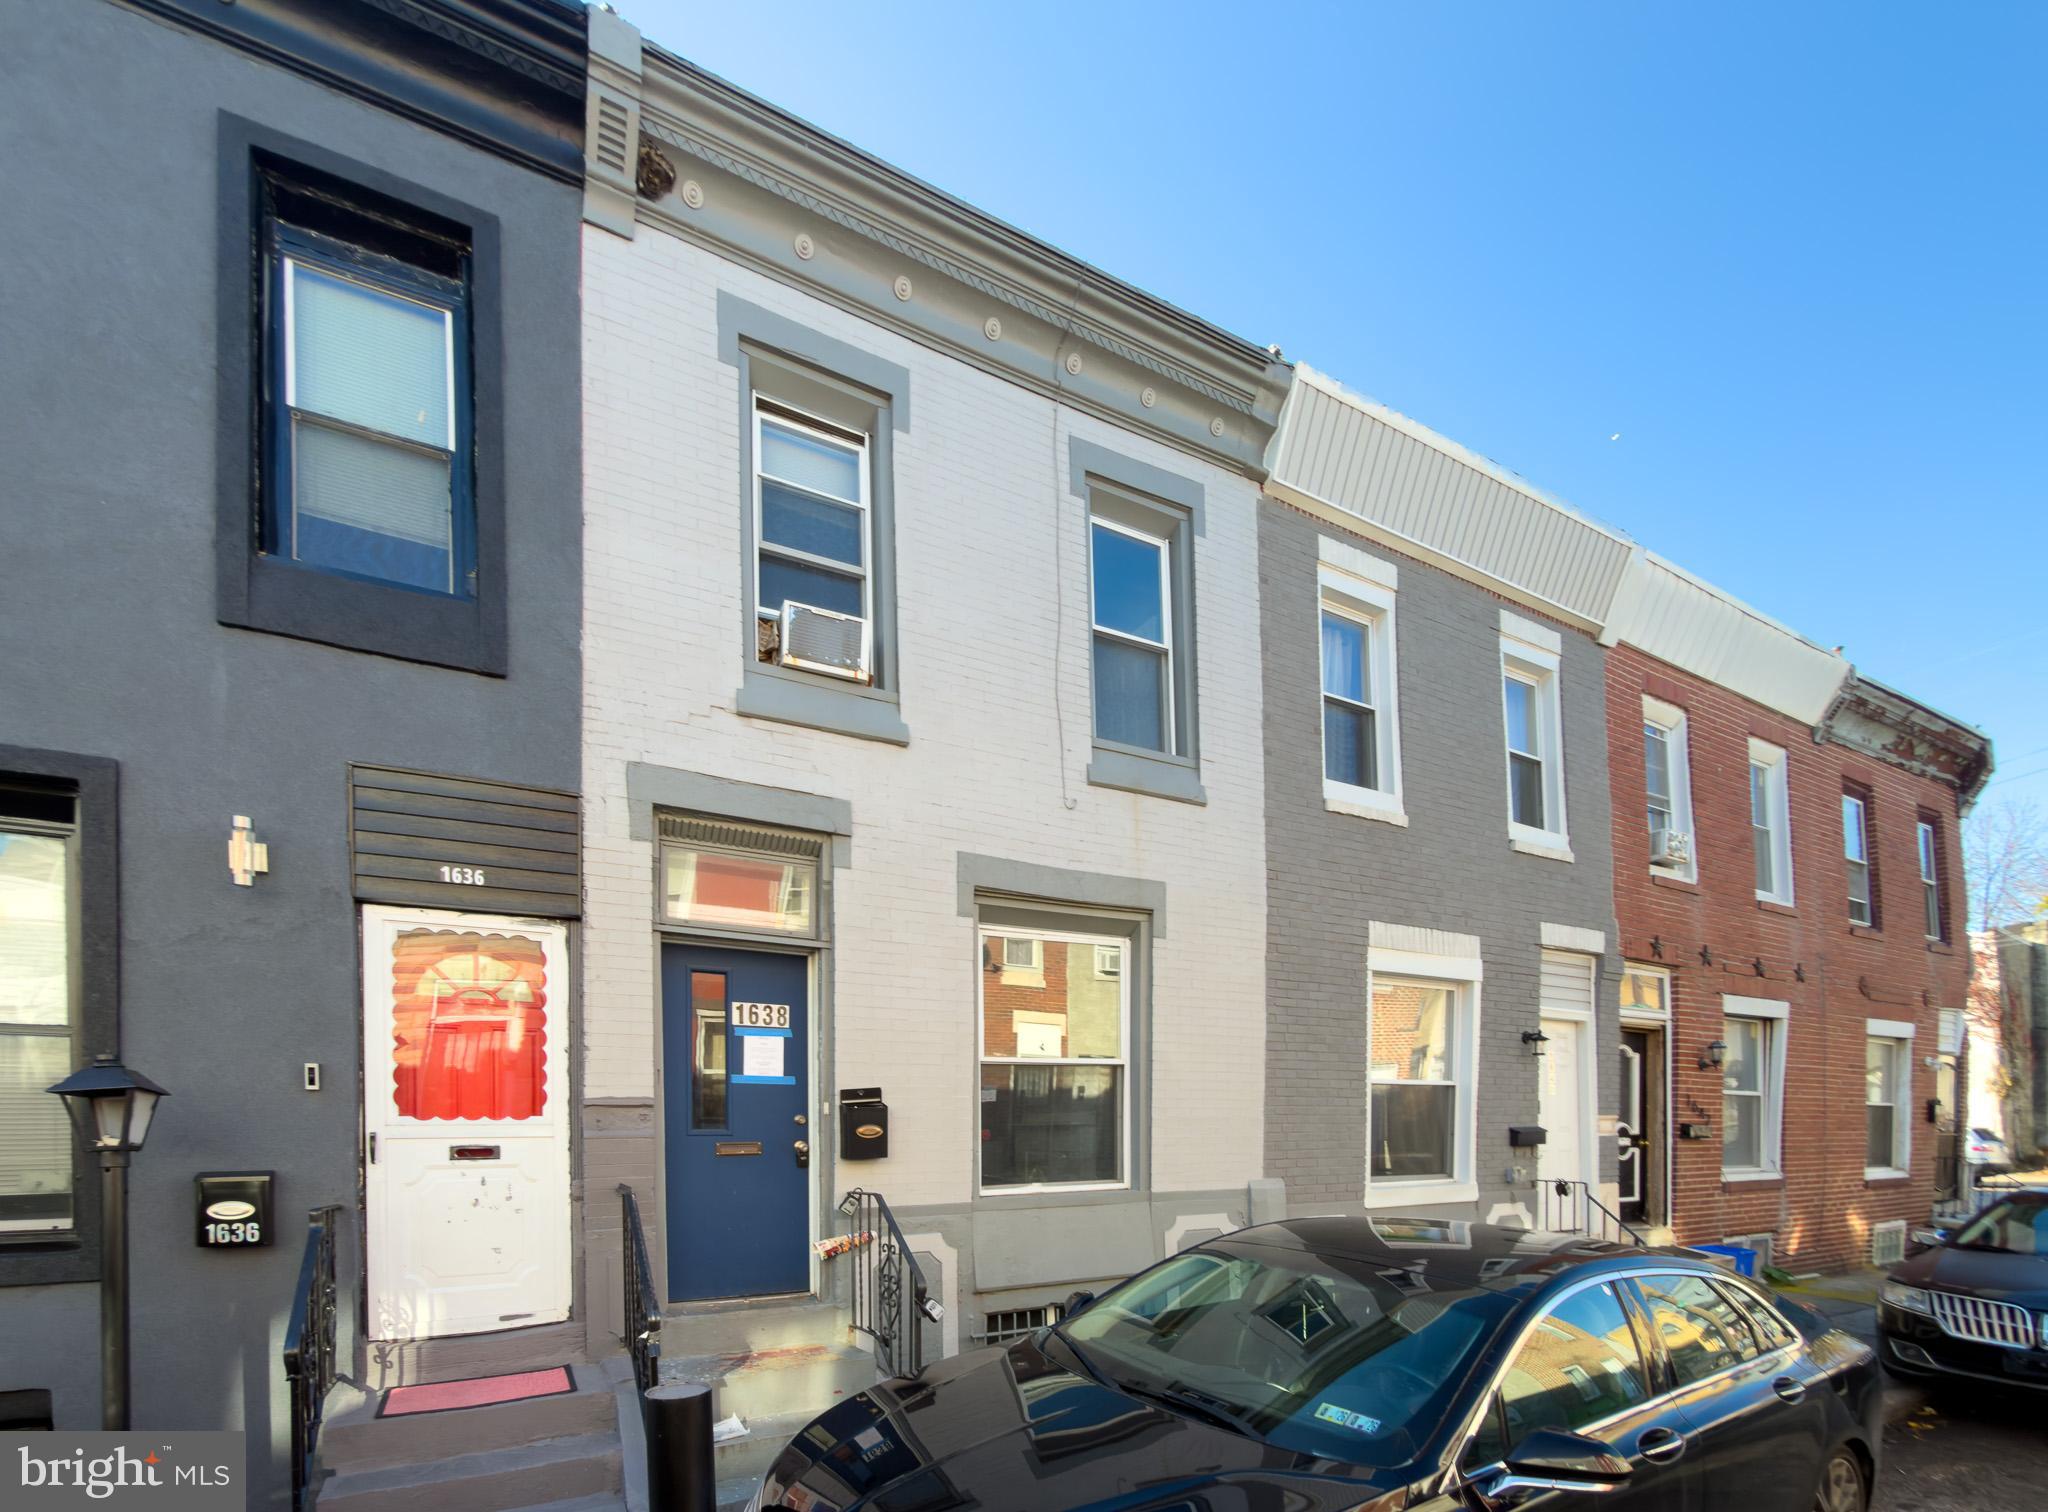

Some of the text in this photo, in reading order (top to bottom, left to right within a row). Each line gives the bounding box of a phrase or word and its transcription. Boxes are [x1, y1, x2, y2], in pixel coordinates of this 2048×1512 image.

[440, 866, 485, 886] 1636
[735, 1003, 788, 1027] 1638
[205, 1222, 260, 1244] 1636
